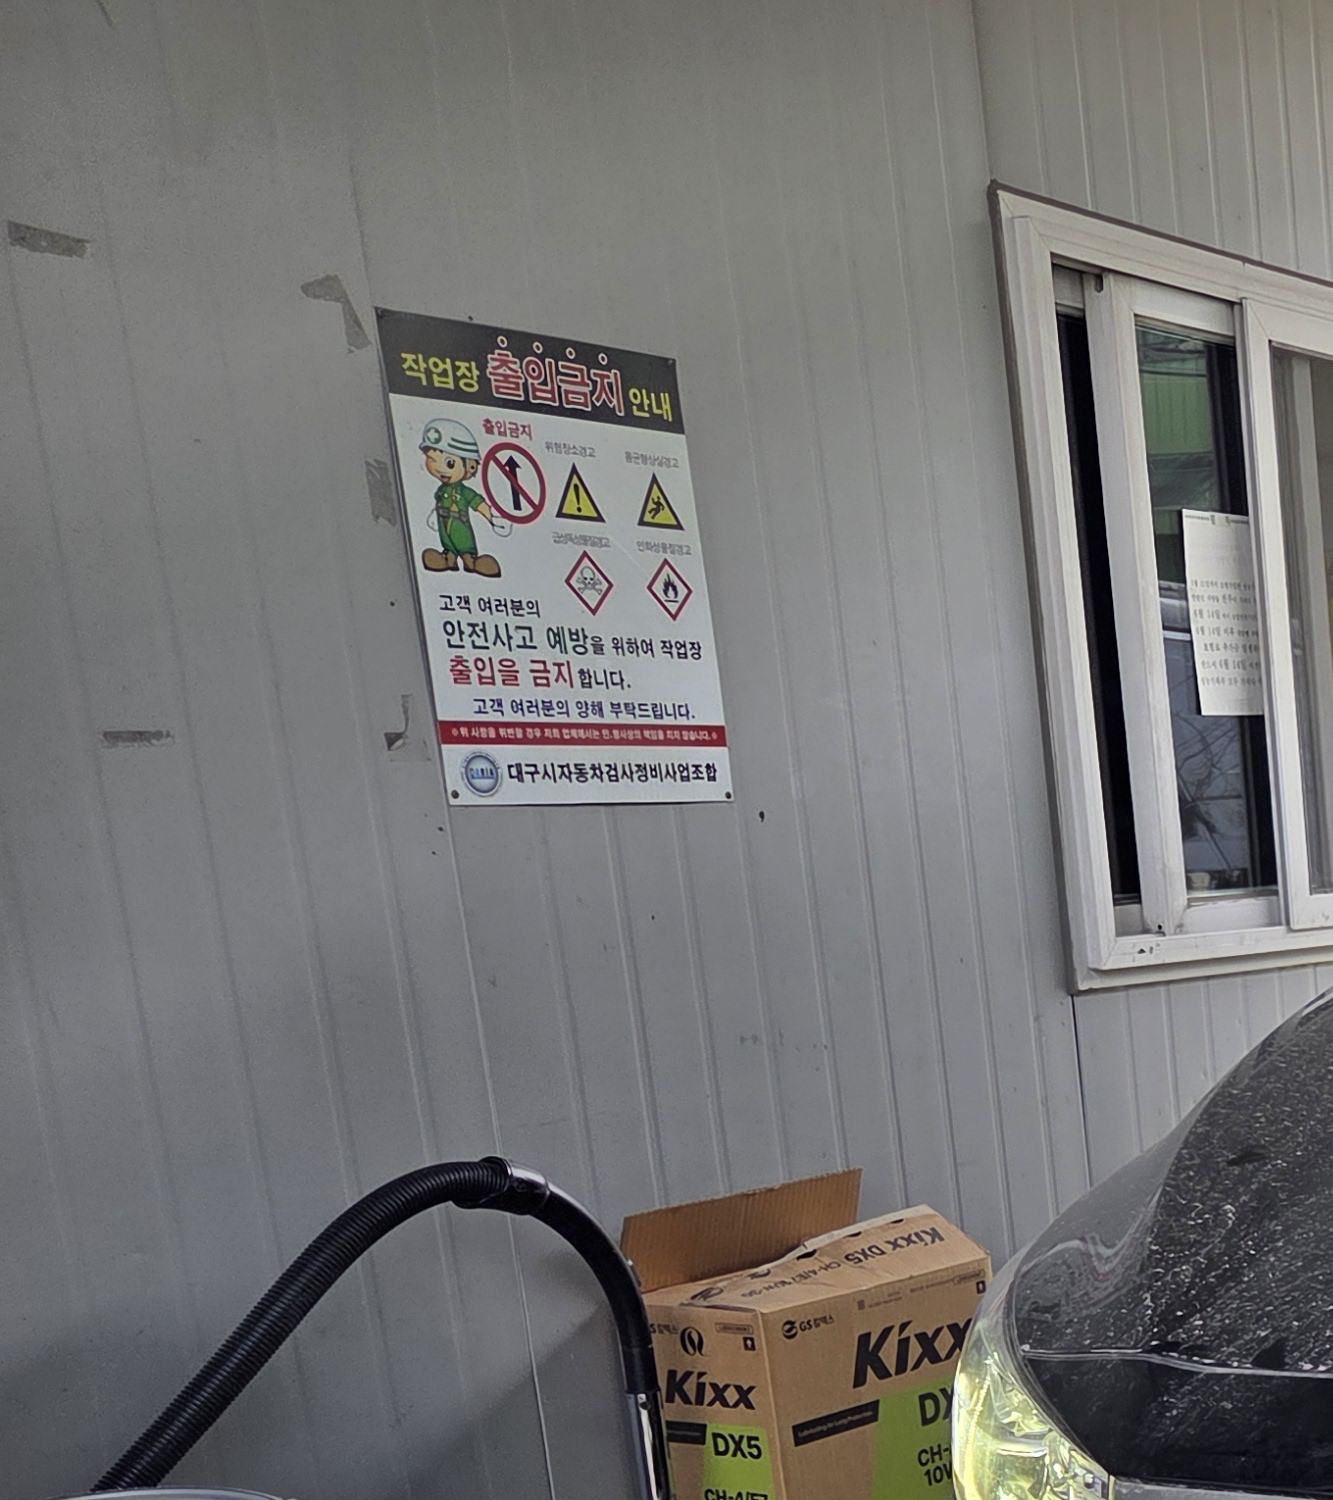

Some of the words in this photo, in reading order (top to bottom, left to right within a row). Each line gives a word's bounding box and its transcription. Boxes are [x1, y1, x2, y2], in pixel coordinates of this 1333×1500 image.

[401, 352, 480, 393] 작업장
[485, 347, 626, 417] 출입금지
[628, 386, 674, 423] 안내
[482, 417, 533, 440] 출입금지
[439, 594, 472, 614] 고객
[477, 596, 541, 619] 여러분의
[442, 619, 538, 653] 안전사고
[546, 625, 606, 657] 예방을
[611, 636, 655, 659] 위하여
[659, 638, 703, 661] 작업장
[449, 654, 521, 687] 출입을
[529, 658, 574, 689] 금지
[577, 667, 632, 691] 합니다.
[473, 697, 504, 717] 고객
[510, 699, 571, 719] 여러분의
[575, 700, 605, 719] 양해
[609, 701, 696, 721] 부탁드립니다.
[507, 761, 718, 784] 대구시자동차검사정비사업조합
[844, 1242, 887, 1265] DX5
[885, 1226, 946, 1252] Kixx
[852, 1319, 973, 1389] Kixx
[665, 1368, 757, 1411] Kixx
[917, 1387, 953, 1427] DX
[711, 1431, 763, 1460] DX5
